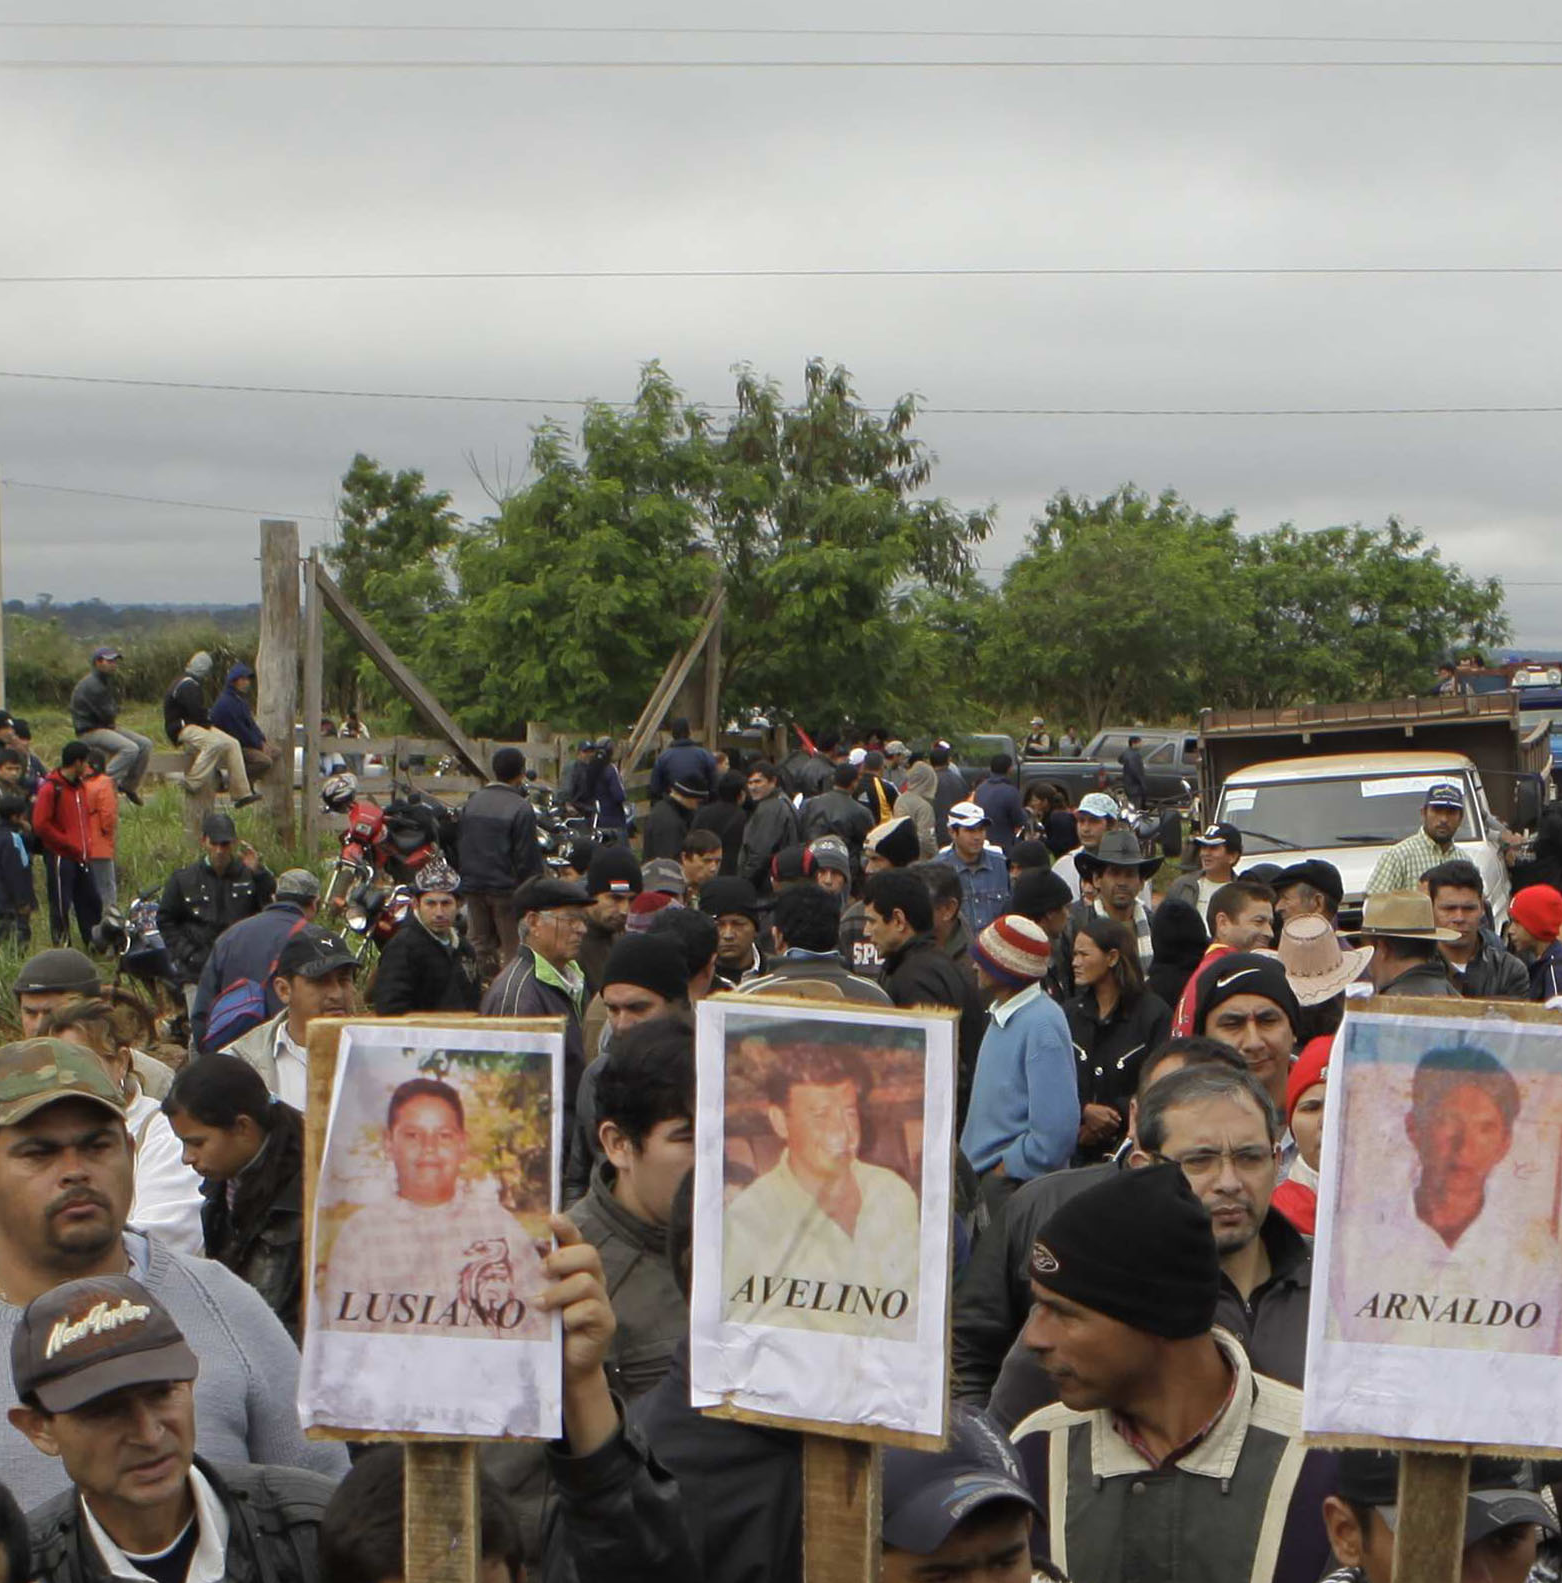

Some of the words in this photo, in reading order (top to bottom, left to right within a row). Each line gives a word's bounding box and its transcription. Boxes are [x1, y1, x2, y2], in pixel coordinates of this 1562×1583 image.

[337, 1291, 526, 1330] LUSIANO
[729, 1273, 909, 1320] AVELINO
[1355, 1291, 1542, 1330] ARNALDO
